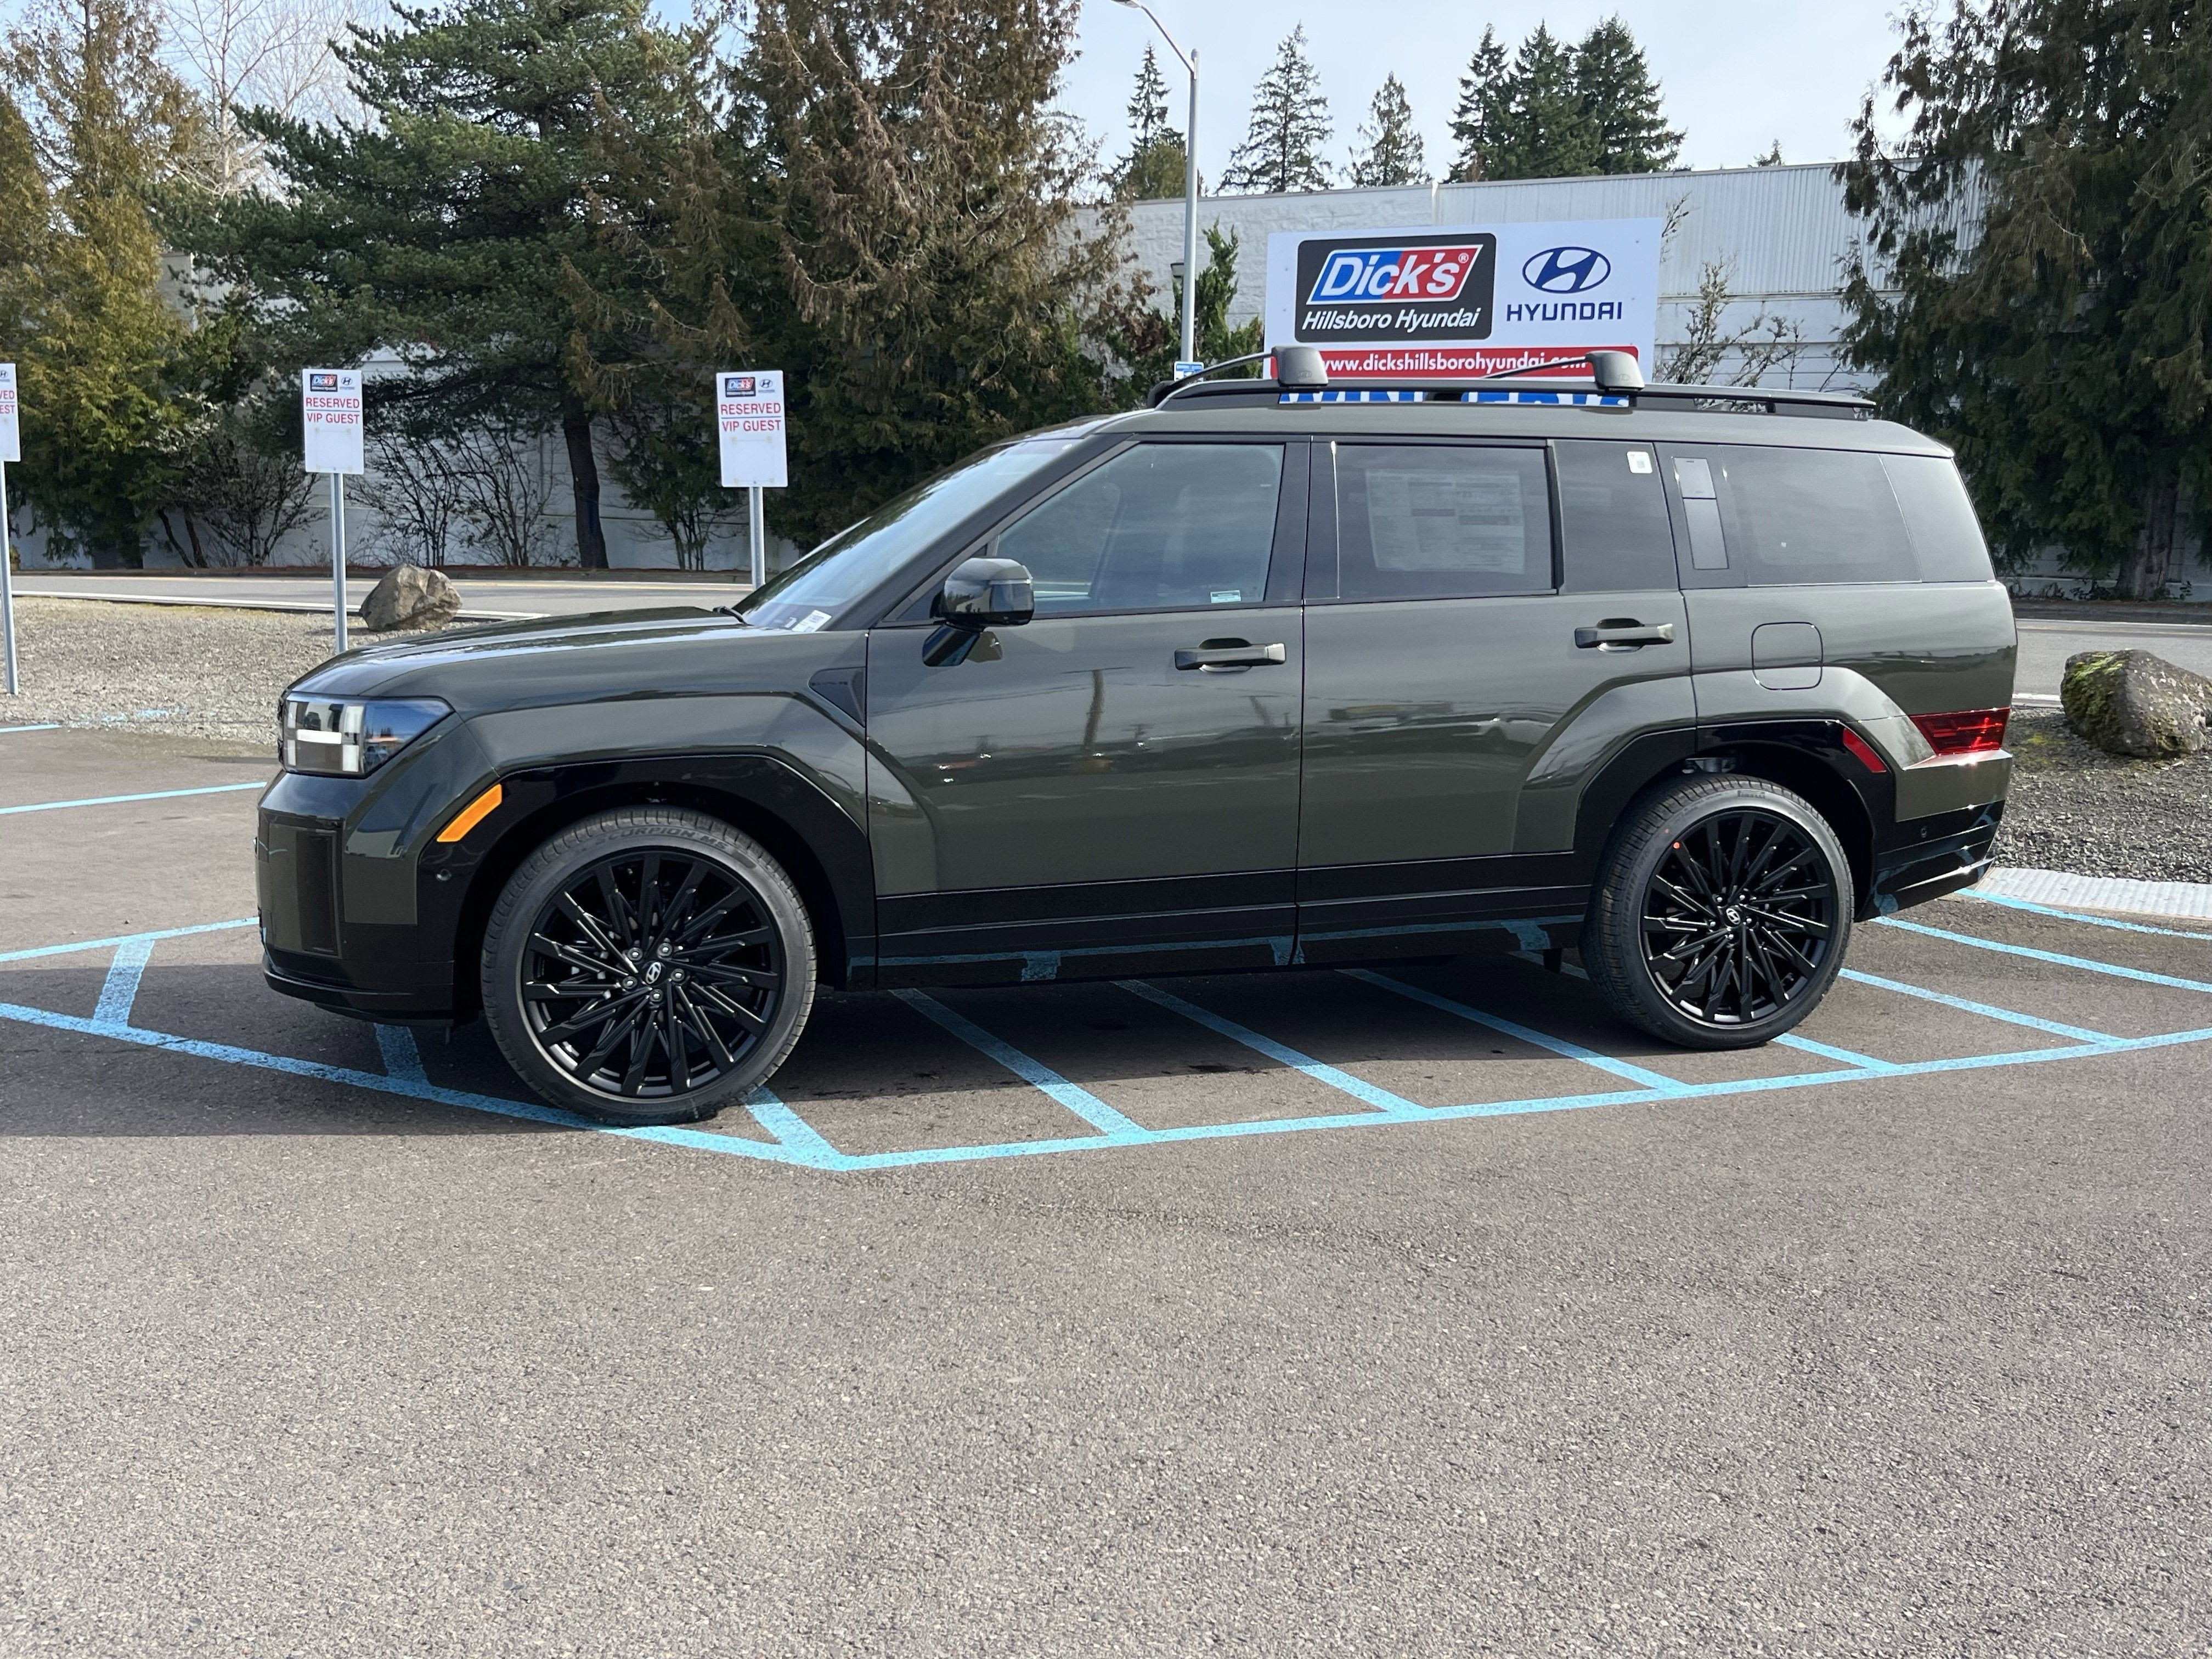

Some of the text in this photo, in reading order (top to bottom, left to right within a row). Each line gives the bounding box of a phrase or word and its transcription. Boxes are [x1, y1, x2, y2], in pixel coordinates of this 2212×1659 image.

[1320, 252, 1460, 296] Dick's
[1506, 302, 1623, 321] HYUNDAI
[1302, 308, 1482, 333] Hillsboro Hyundai
[1324, 351, 1587, 374] ww.dickshillsborohyundaio
[306, 397, 360, 409] RESERVED
[720, 402, 781, 415] RESERVED
[307, 413, 360, 424] VIP GUEST
[721, 420, 781, 432] VIP GUEST
